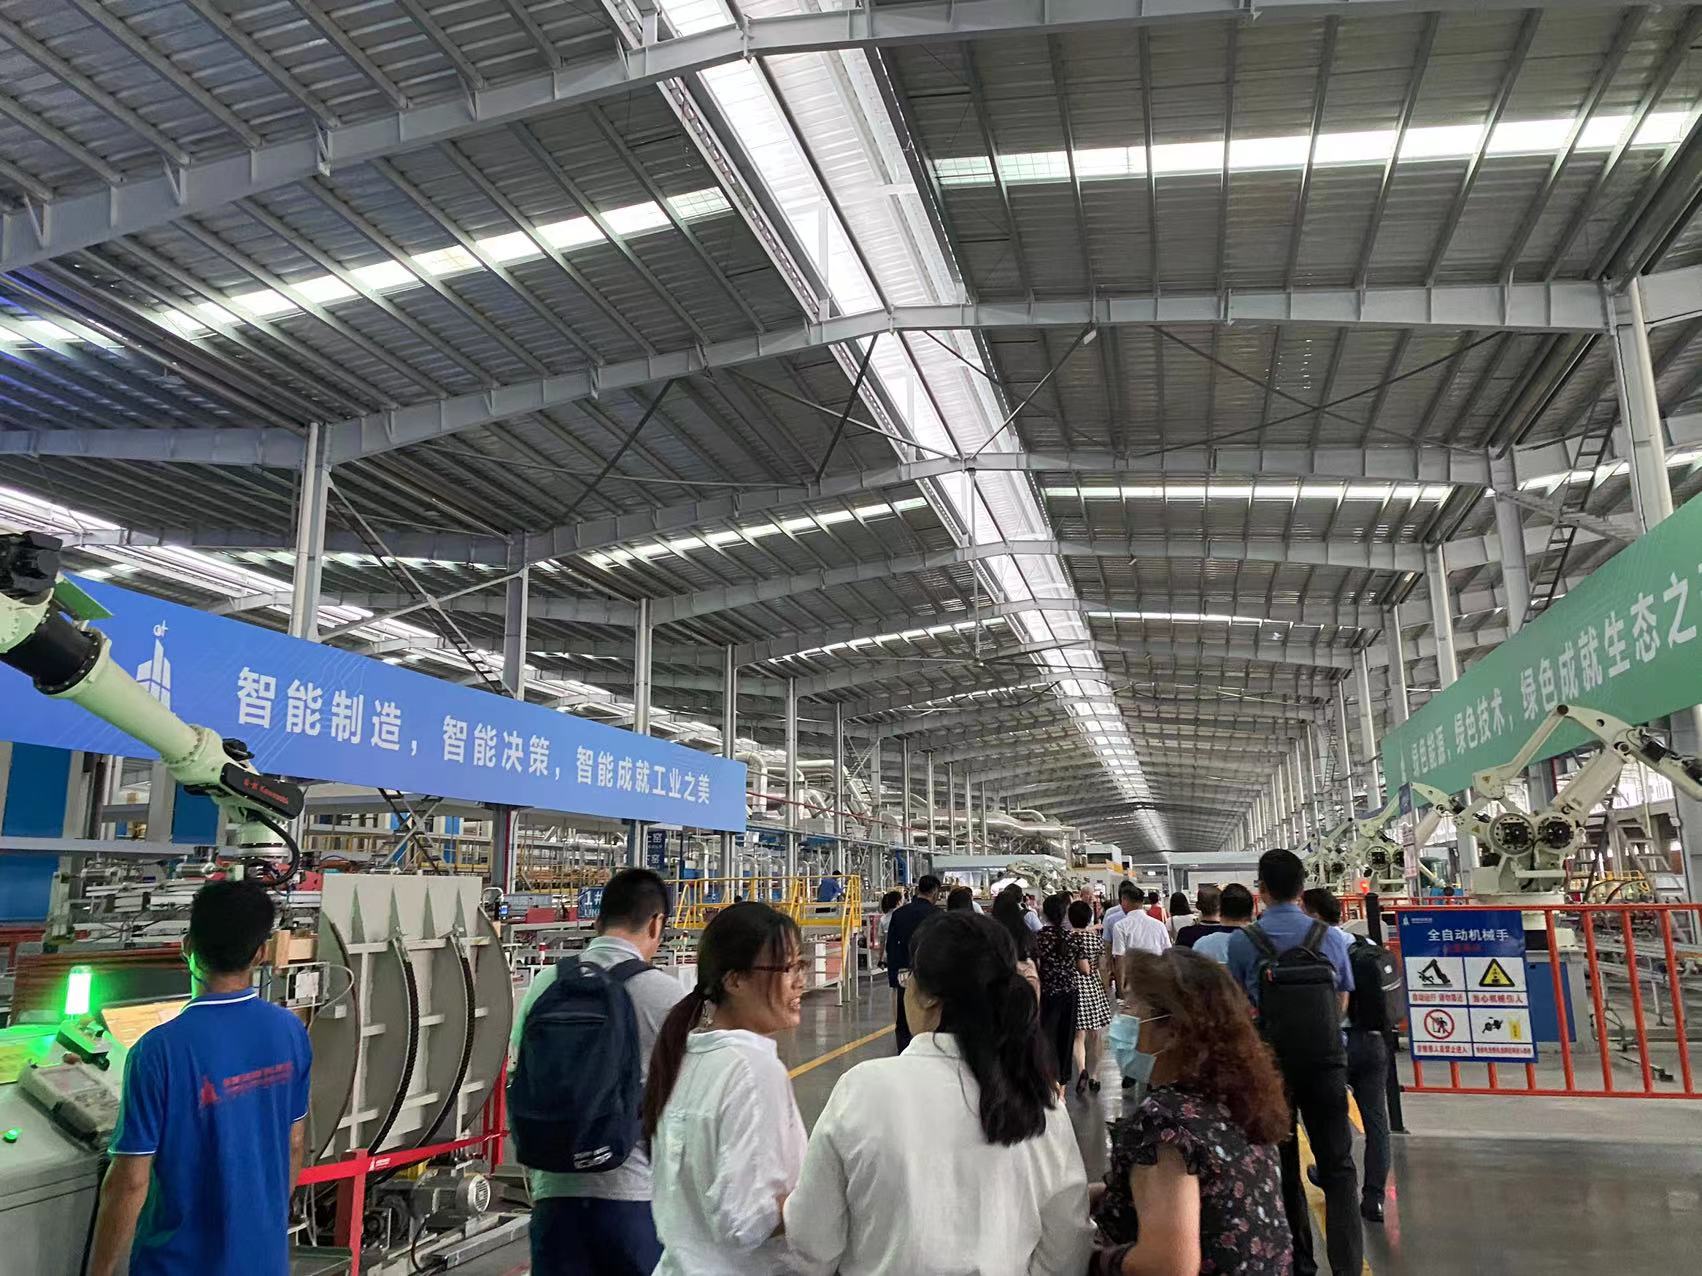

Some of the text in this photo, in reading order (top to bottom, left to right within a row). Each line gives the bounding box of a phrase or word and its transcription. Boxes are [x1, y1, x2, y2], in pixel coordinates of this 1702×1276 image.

[237, 667, 710, 804] 智能制造，智能决策，智能成就工业之美
[1411, 563, 1702, 777] 绿色能源，绿色技术，绿色成就生态之
[1428, 928, 1509, 941] 全自动机械手
